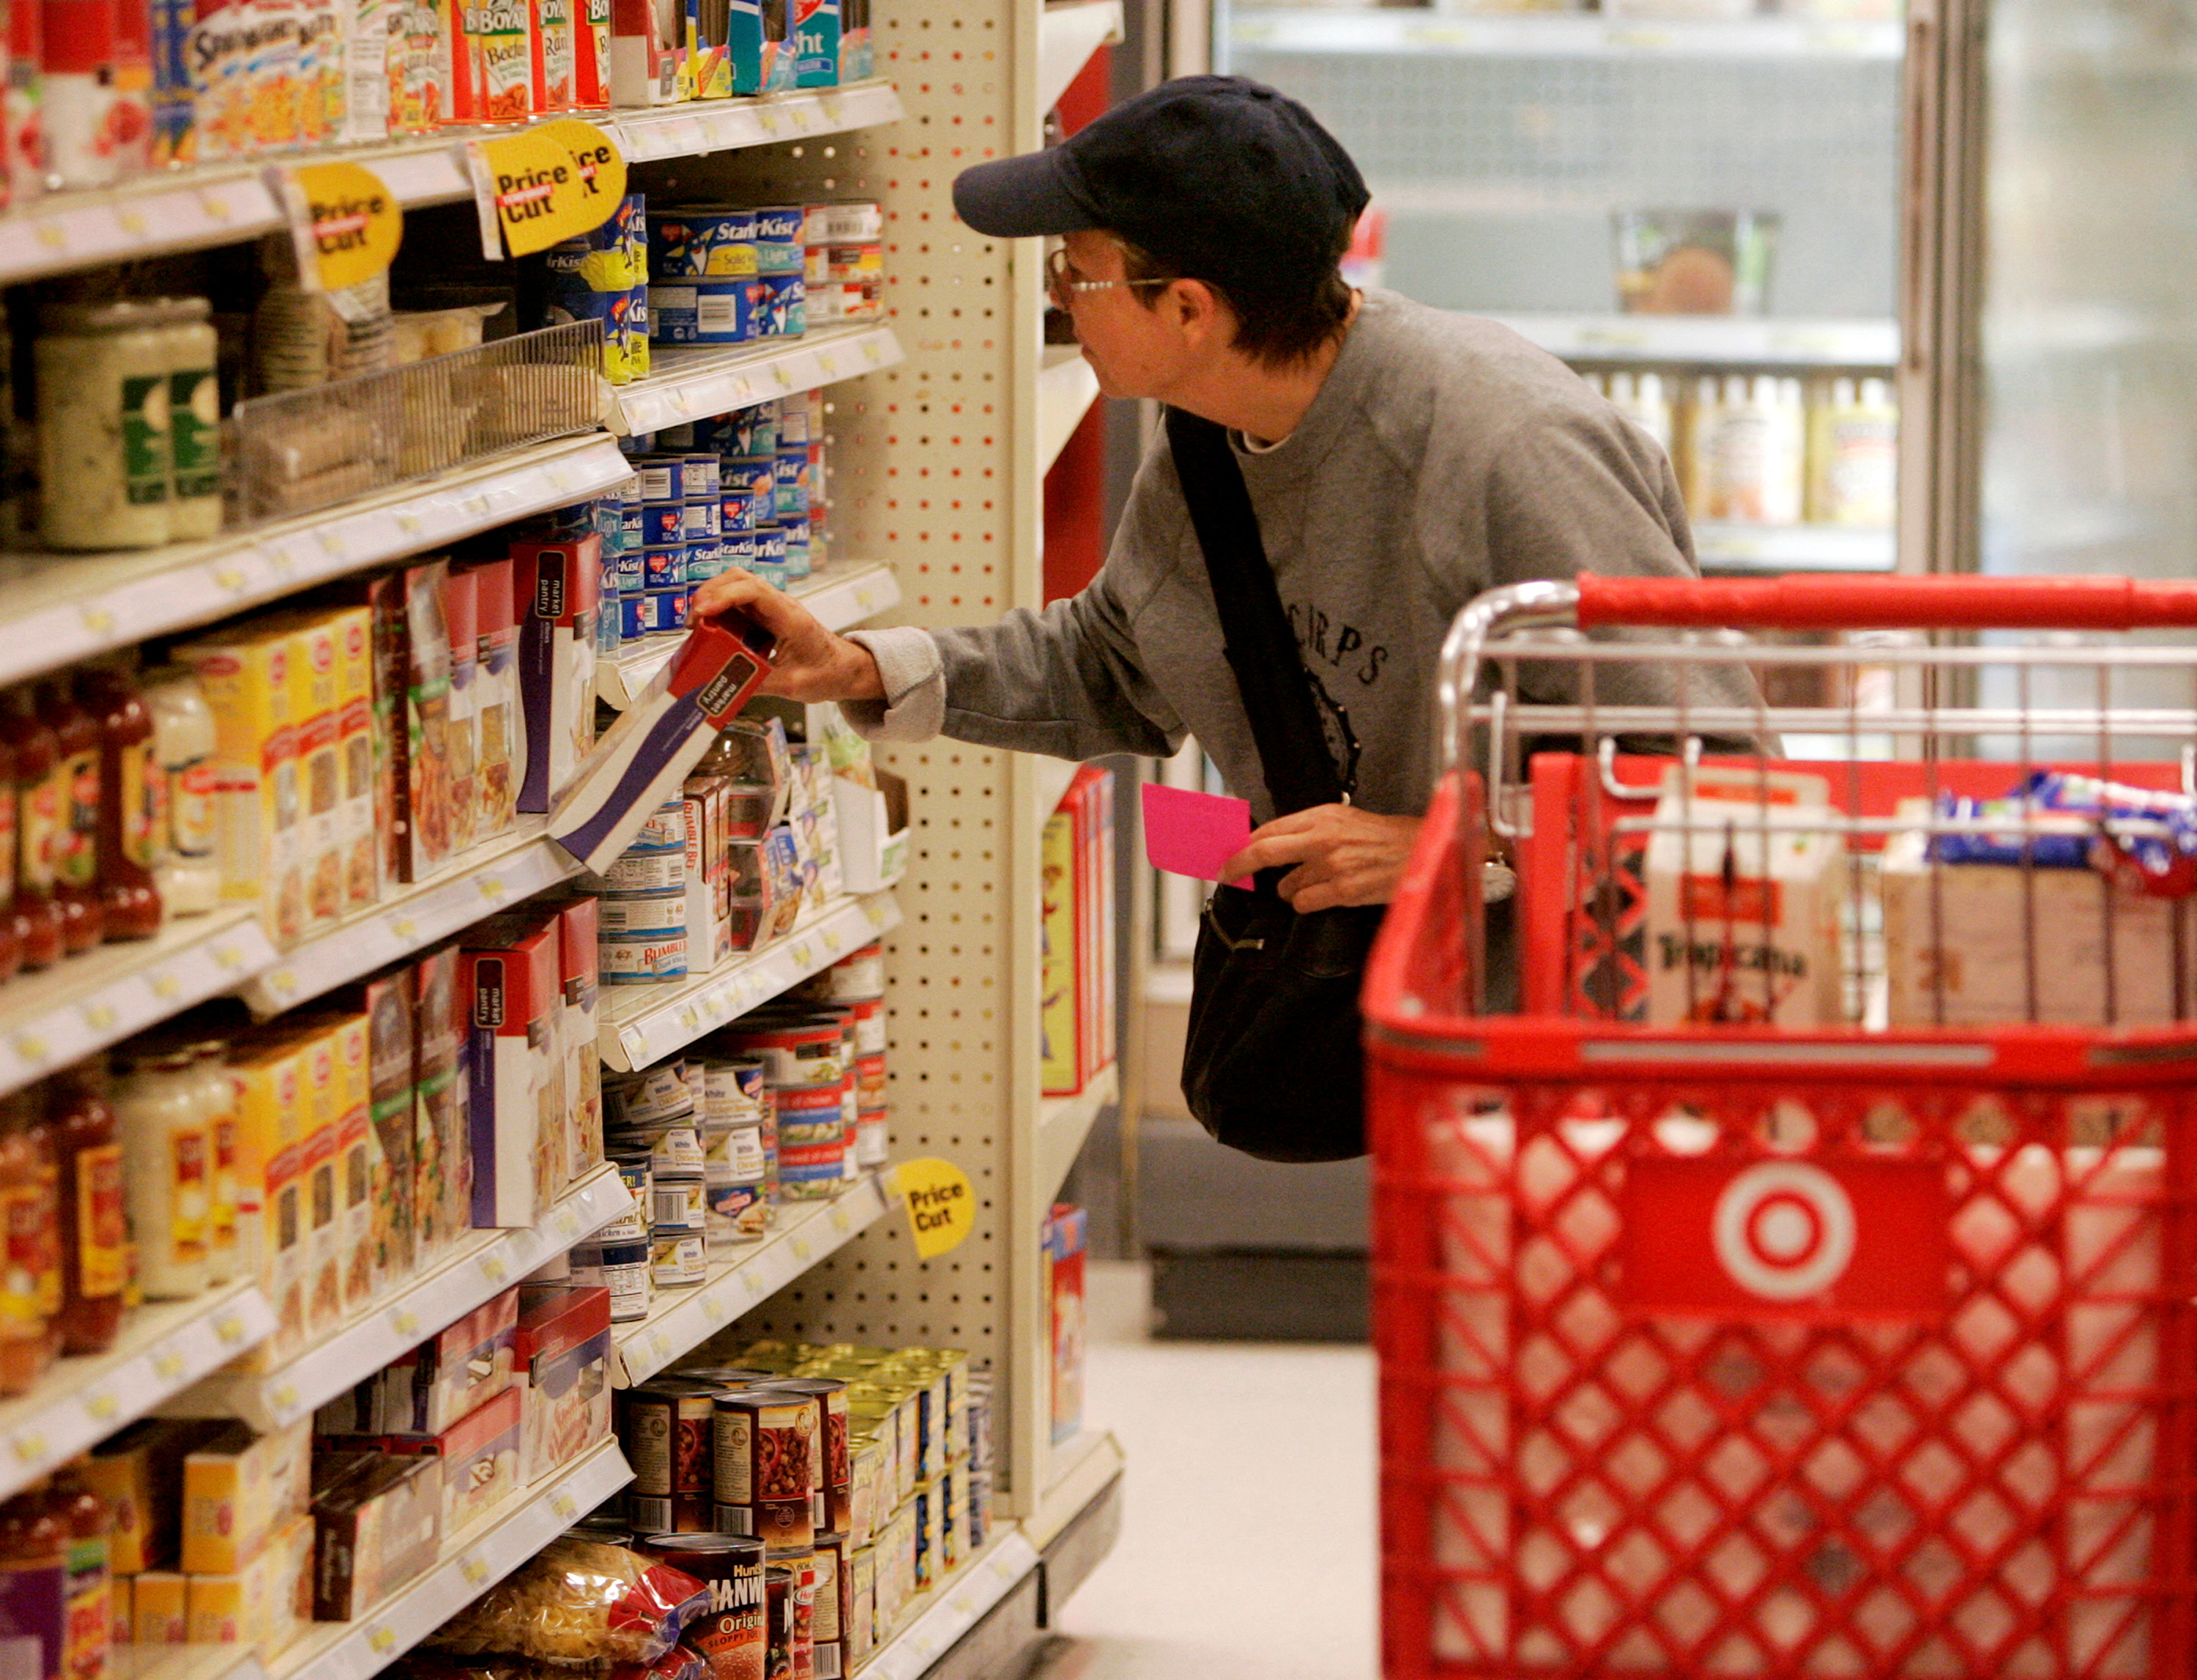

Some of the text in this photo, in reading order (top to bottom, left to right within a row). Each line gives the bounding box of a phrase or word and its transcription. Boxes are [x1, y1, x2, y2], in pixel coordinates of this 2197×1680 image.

[498, 165, 568, 194] Price
[308, 194, 384, 225] Price
[504, 194, 555, 223] Cut
[538, 579, 549, 612] pantry
[551, 579, 561, 615] market
[702, 674, 729, 705] pantry
[710, 683, 737, 713] market
[684, 801, 698, 871] BUMBLE BEE
[478, 988, 489, 1022] pantry
[491, 988, 502, 1025] market
[910, 1183, 964, 1209] Price
[916, 1208, 953, 1232] Cut
[733, 1562, 762, 1578] Hunt's
[707, 1632, 744, 1649] SLOPPY
